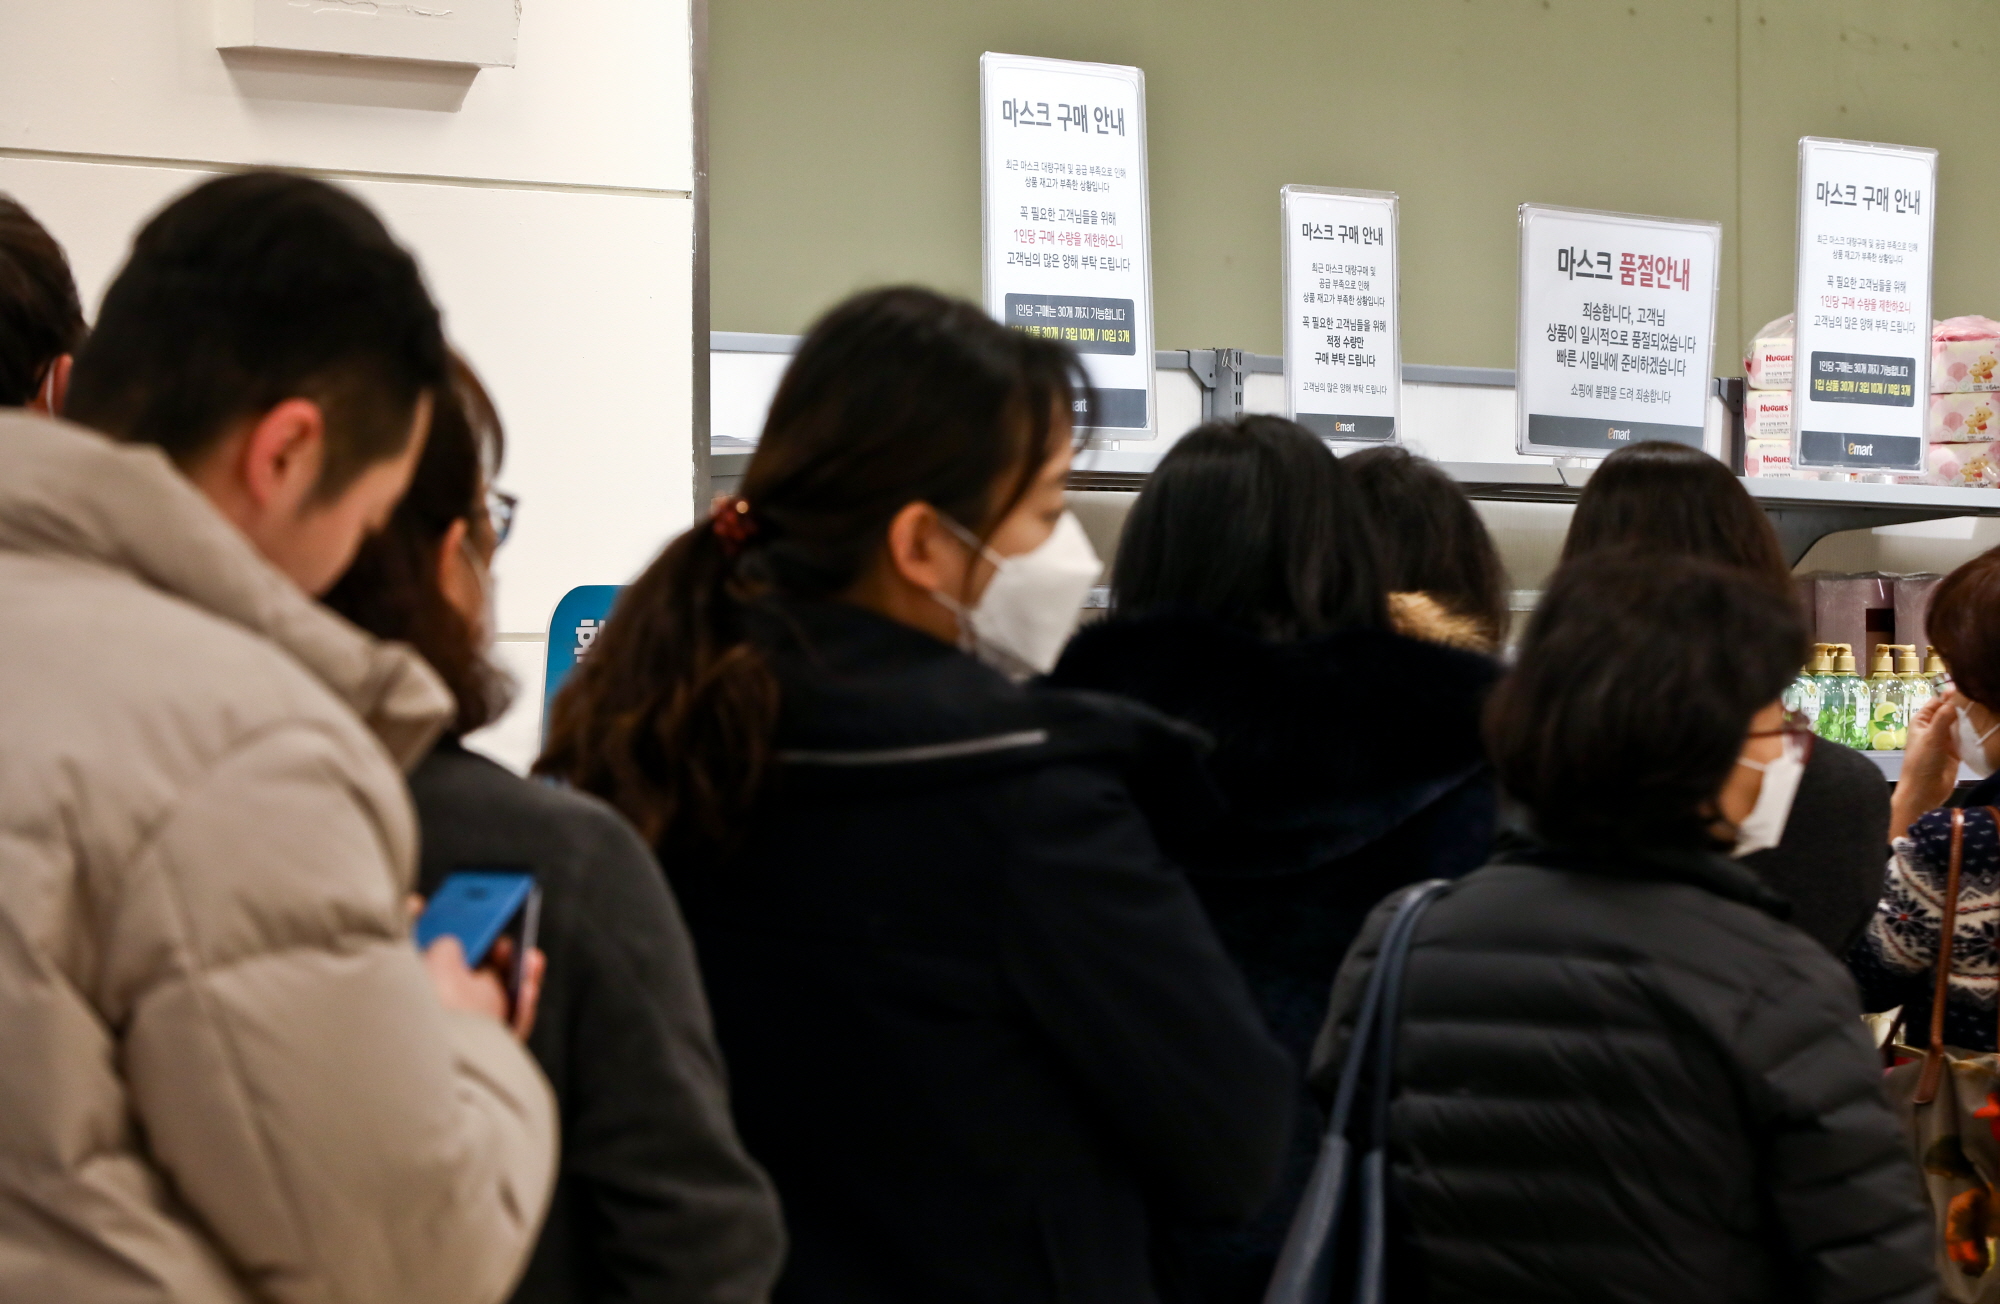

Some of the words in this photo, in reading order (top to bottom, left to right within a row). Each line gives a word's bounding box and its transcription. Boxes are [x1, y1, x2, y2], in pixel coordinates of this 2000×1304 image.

[1002, 98, 1051, 127] 마스크
[1057, 104, 1088, 133] 구매
[1094, 106, 1125, 136] 안내
[1006, 159, 1019, 170] 최근
[1021, 160, 1039, 172] 마스크
[1041, 162, 1065, 174] 대량구매
[1068, 163, 1074, 175] 및
[1076, 164, 1087, 176] 공급
[1089, 166, 1113, 177] 부족으로
[1114, 167, 1126, 179] 인해
[1025, 177, 1037, 188] 상품
[1040, 178, 1058, 189] 재고가
[1060, 179, 1078, 191] 부족한
[1080, 180, 1110, 193] 상황입니다
[1817, 181, 1857, 207] 마스크
[1863, 186, 1890, 213] 구매
[1895, 189, 1921, 216] 안내
[1020, 206, 1028, 220] 꼭
[1031, 207, 1056, 222] 필요한
[1058, 209, 1098, 225] 고객님들을
[1101, 212, 1117, 226] 위해
[1014, 229, 1036, 244] 1인당
[1039, 230, 1055, 245] 구매
[1058, 231, 1082, 247] 수량을
[1084, 233, 1124, 249] 제한하오니
[1302, 222, 1334, 241] 마스크
[1338, 225, 1359, 244] 구매
[1363, 227, 1383, 246] 안내
[1829, 235, 1845, 246] 마스크
[1007, 252, 1041, 267] 고객님의
[1044, 254, 1060, 268] 많은
[1063, 255, 1079, 269] 양해
[1081, 256, 1097, 270] 부탁
[1100, 257, 1131, 272] 드립니다
[1833, 250, 1843, 260] 상품
[1845, 251, 1861, 261] 재고가
[1862, 252, 1877, 263] 부족한
[1878, 253, 1904, 265] 상황입니다
[1312, 263, 1324, 274] 최근
[1326, 264, 1344, 274] 마스크
[1345, 265, 1369, 276] 대량구매
[1370, 266, 1376, 277] 및
[1557, 246, 1613, 280] 마스크
[1619, 252, 1690, 292] 품절안내
[1319, 278, 1331, 289] 공급
[1333, 279, 1356, 290] 부족으로
[1358, 281, 1370, 291] 인해
[1827, 275, 1834, 288] 꼭
[1837, 276, 1857, 290] 필요한
[1859, 278, 1892, 292] 고객님들을
[1894, 281, 1907, 294] 위해
[1303, 293, 1315, 303] 상품
[1317, 293, 1335, 304] 재고가
[1337, 295, 1355, 306] 부족한
[1356, 295, 1385, 307] 상황입니다
[1821, 296, 1839, 309] 1인당
[1842, 297, 1855, 310] 구매
[1857, 298, 1877, 312] 수량을
[1879, 299, 1911, 314] 제한하오니
[1016, 304, 1033, 317] 1인당
[1035, 305, 1057, 318] 구매는
[1058, 306, 1074, 319] 30개
[1075, 307, 1089, 319] 까지
[1091, 307, 1126, 321] 가능합니다
[1583, 302, 1634, 325] 죄송합니다,
[1637, 308, 1666, 327] 고객님
[1303, 316, 1310, 328] 꼭
[1312, 317, 1334, 330] 필요한
[1336, 319, 1370, 332] 고객님들을
[1373, 320, 1386, 333] 위해
[1814, 315, 1842, 329] 고객님의
[1845, 317, 1858, 330] 많은
[1860, 318, 1873, 331] 양해
[1875, 319, 1888, 332] 부탁
[1890, 320, 1916, 334] 드립니다
[1042, 327, 1059, 340] 30개
[1066, 328, 1078, 341] 3입
[1080, 329, 1095, 342] 10개
[1102, 330, 1117, 343] 10입
[1118, 330, 1130, 343] 3개
[1327, 335, 1340, 348] 적정
[1343, 336, 1364, 349] 수량만
[1547, 323, 1577, 344] 상품이
[1581, 326, 1629, 347] 일시적으로
[1632, 331, 1697, 354] 품절되었습니다
[1315, 352, 1329, 365] 구매
[1331, 353, 1346, 366] 부탁
[1348, 354, 1376, 367] 드립니다
[1556, 349, 1577, 368] 빠른
[1580, 351, 1618, 372] 시일내에
[1621, 354, 1687, 377] 준비하겠습니다
[1819, 361, 1834, 373] 1인당
[1835, 362, 1854, 374] 구매는
[1854, 363, 1867, 374] 30개
[1868, 364, 1879, 375] 까지
[1880, 365, 1909, 377] 가능합니다
[1303, 382, 1325, 393] 고객님의
[1327, 383, 1339, 393] 많은
[1340, 384, 1351, 394] 양해
[1353, 385, 1364, 394] 부탁
[1366, 385, 1387, 395] 드립니다
[1571, 383, 1594, 398] 쇼핑에
[1596, 385, 1617, 400] 불편을
[1619, 387, 1634, 401] 드려
[1636, 389, 1672, 404] 죄송합니다
[1815, 379, 1825, 391] 1입
[1826, 380, 1840, 392] 상품
[1840, 381, 1855, 393] 30개
[1859, 382, 1870, 394] 3입
[1871, 383, 1883, 395] 10개
[1888, 384, 1900, 396] 10입
[1901, 385, 1911, 397] 3개
[1336, 422, 1355, 432] emart
[1608, 427, 1631, 441] emart
[1848, 443, 1873, 456] emart
[1763, 455, 1791, 463] HUGGIES
